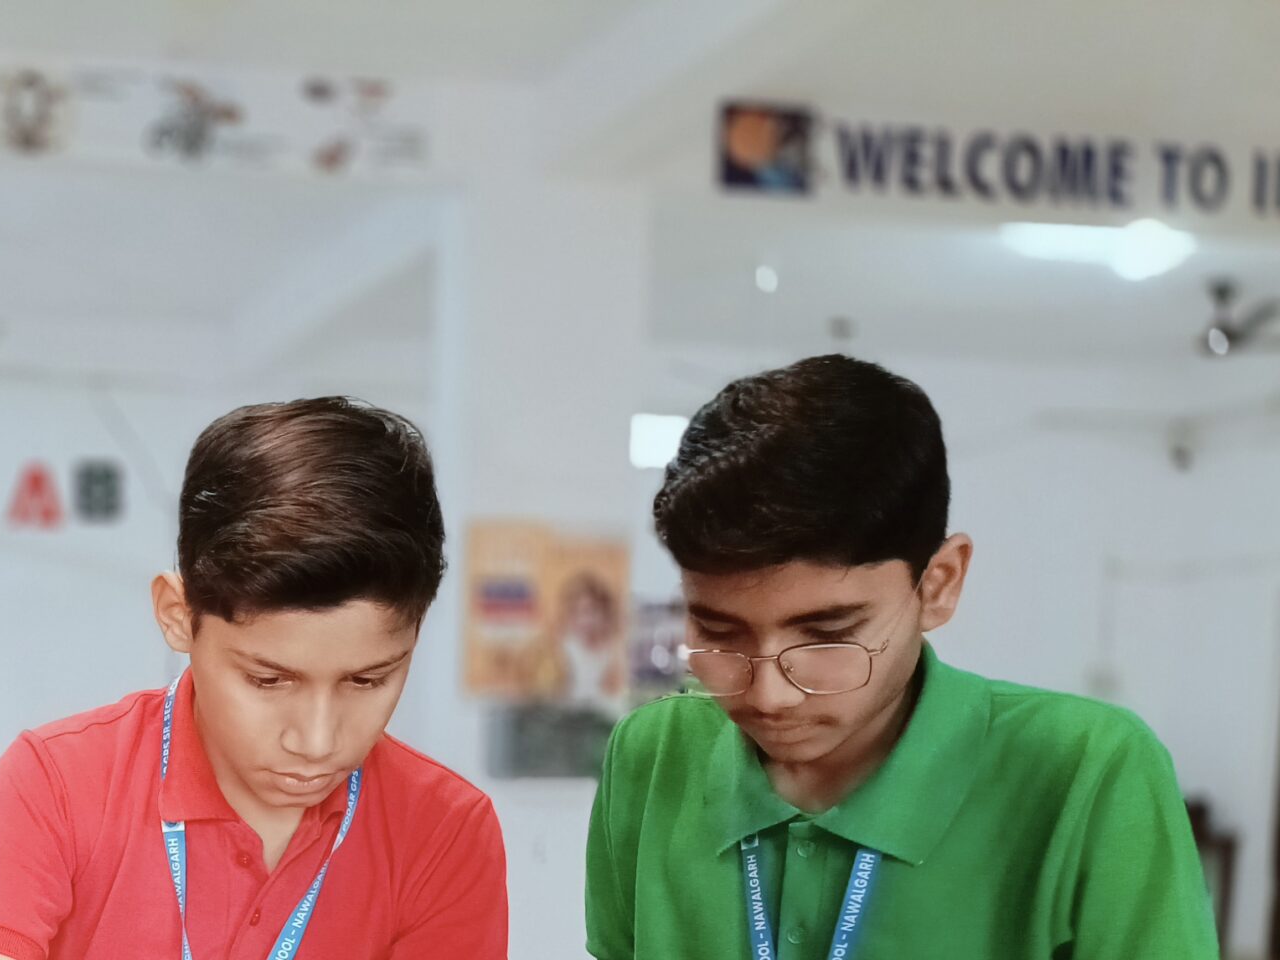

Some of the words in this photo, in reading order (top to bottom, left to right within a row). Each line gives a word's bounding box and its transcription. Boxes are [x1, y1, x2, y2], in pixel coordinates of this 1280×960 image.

[834, 123, 1134, 207] WELCOME
[1154, 141, 1230, 214] TO
[1253, 148, 1280, 217] I
[343, 793, 356, 832] PODAR
[349, 769, 360, 792] GPS
[747, 854, 767, 930] NAWALGARH
[840, 853, 876, 932] NAWALGARH
